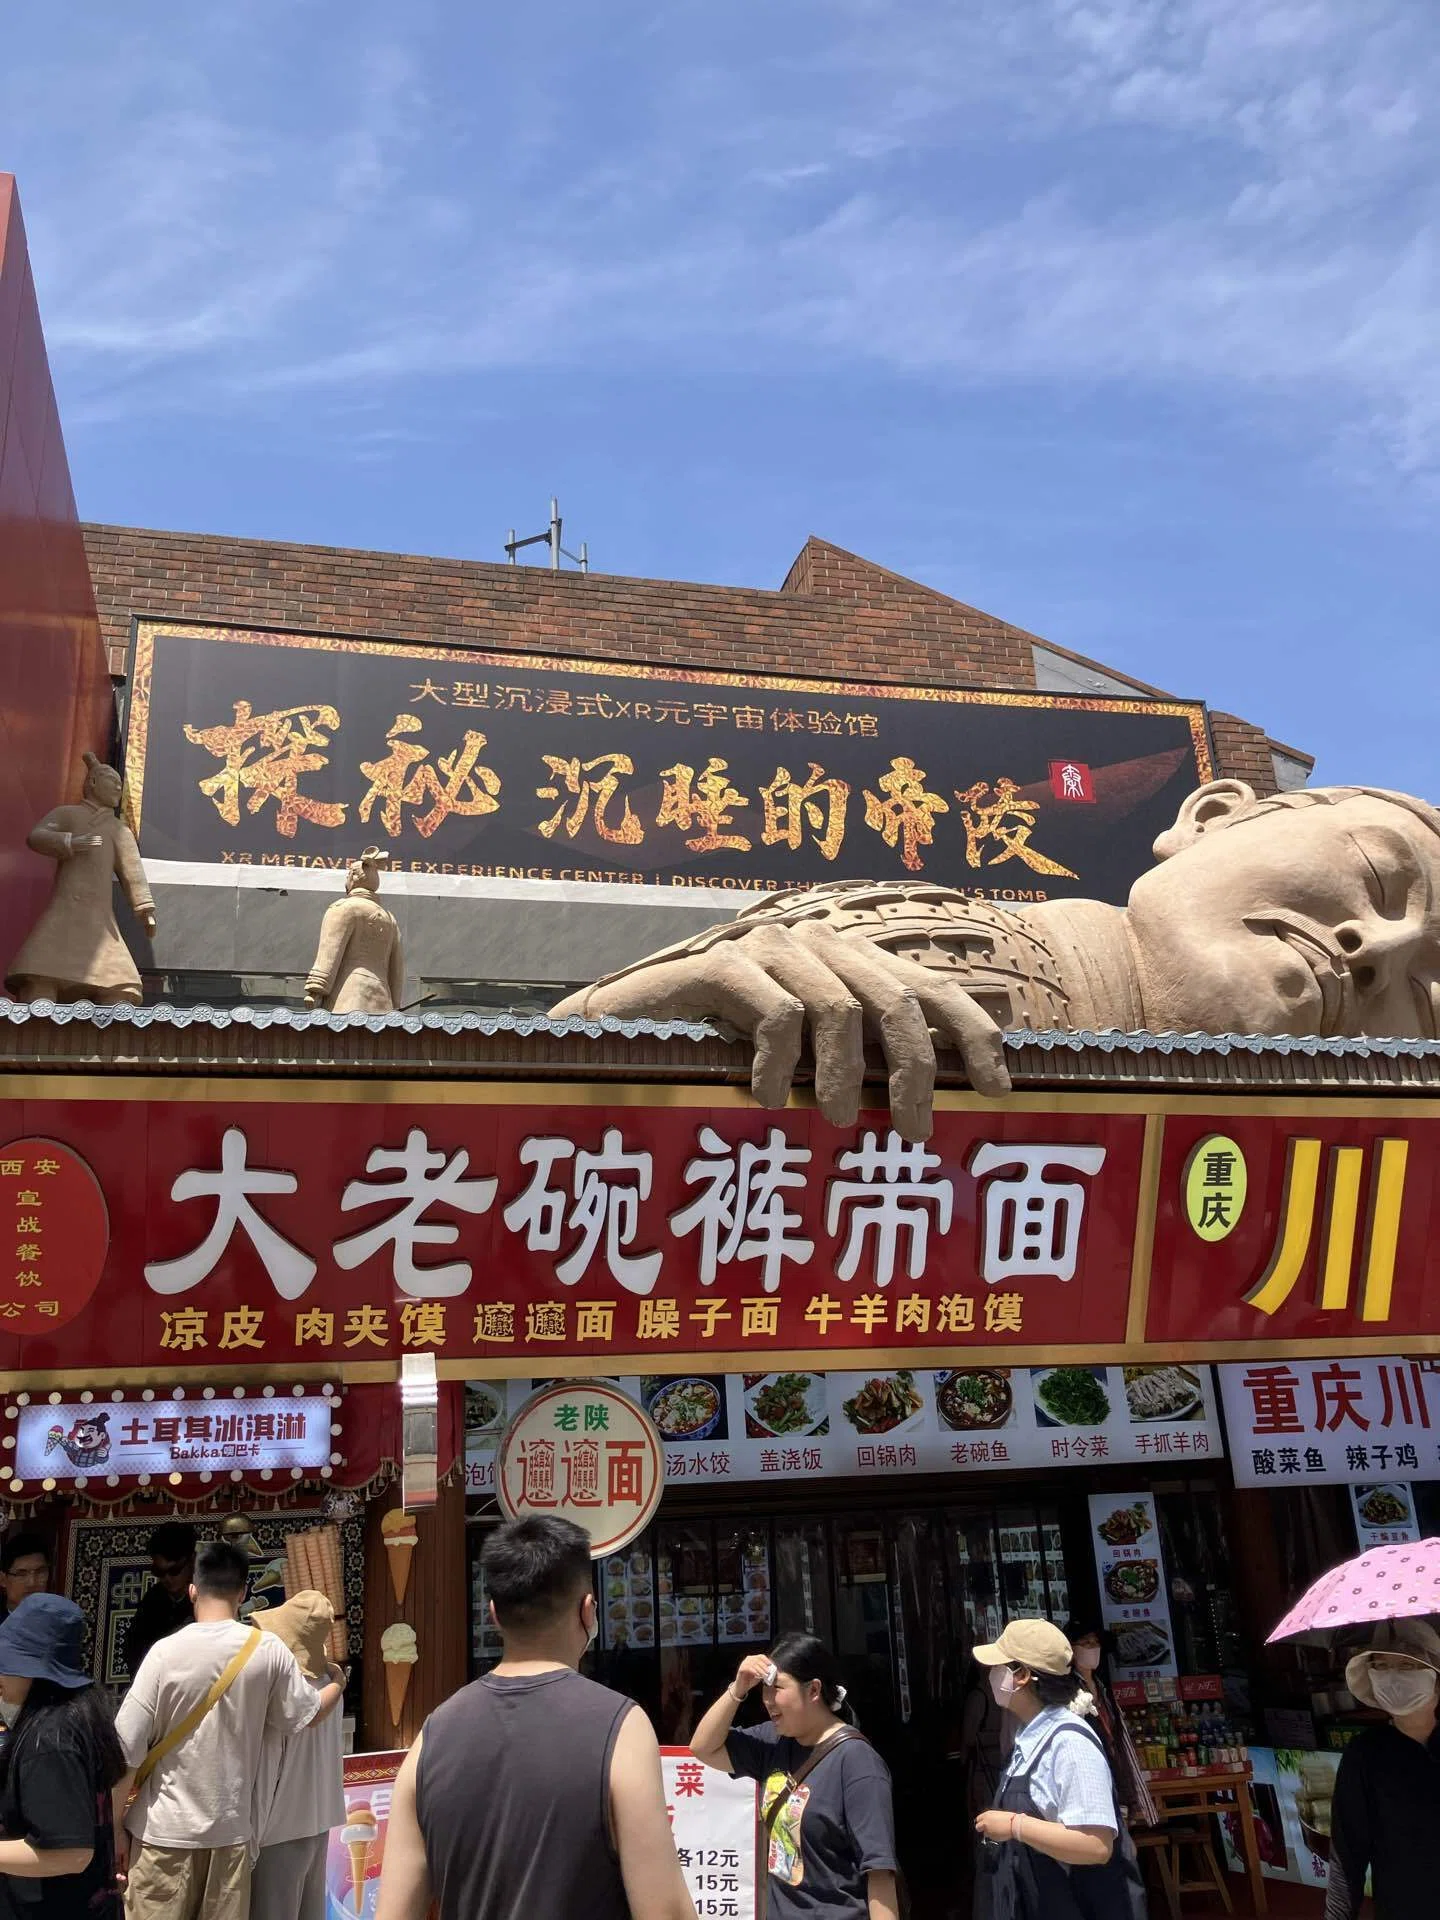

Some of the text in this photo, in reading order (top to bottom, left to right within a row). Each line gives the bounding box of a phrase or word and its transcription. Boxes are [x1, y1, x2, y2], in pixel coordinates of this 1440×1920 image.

[408, 677, 880, 738] 大型沉浸式XR元宇宙体验馆
[183, 699, 1080, 881] 探秘沉睡的帝陵
[410, 861, 552, 881] EXPERIENCE
[559, 869, 643, 886] CENTER
[672, 875, 778, 892] DISCOVER
[989, 887, 1048, 902] TOMB
[0, 1159, 60, 1176] 西安
[1197, 1151, 1237, 1229] 重庆
[144, 1126, 1106, 1300] 大老碗裤带面
[1243, 1139, 1409, 1322] 川
[0, 1300, 59, 1317] 公司
[160, 1305, 266, 1350] 凉皮
[295, 1302, 447, 1347] 肉夹馍
[636, 1297, 782, 1339] 臊子面
[804, 1293, 1024, 1335] 牛羊肉泡馍
[553, 1404, 609, 1432] 老陕
[1243, 1363, 1431, 1434] 重庆川
[120, 1412, 306, 1446] 土耳其冰淇淋
[665, 1451, 730, 1477] 汤水饺
[760, 1447, 823, 1473] 盖浇饭
[857, 1443, 917, 1468] 回锅肉
[951, 1440, 1010, 1464] 老碗鱼
[1051, 1435, 1109, 1459] 时令菜
[1135, 1431, 1209, 1455] 手抓羊肉
[1252, 1447, 1327, 1475] 酸菜鱼
[1346, 1443, 1419, 1471] 辣子鸡
[675, 1763, 705, 1797] 菜
[695, 1873, 740, 1892] 15元
[694, 1898, 740, 1917] 15元
